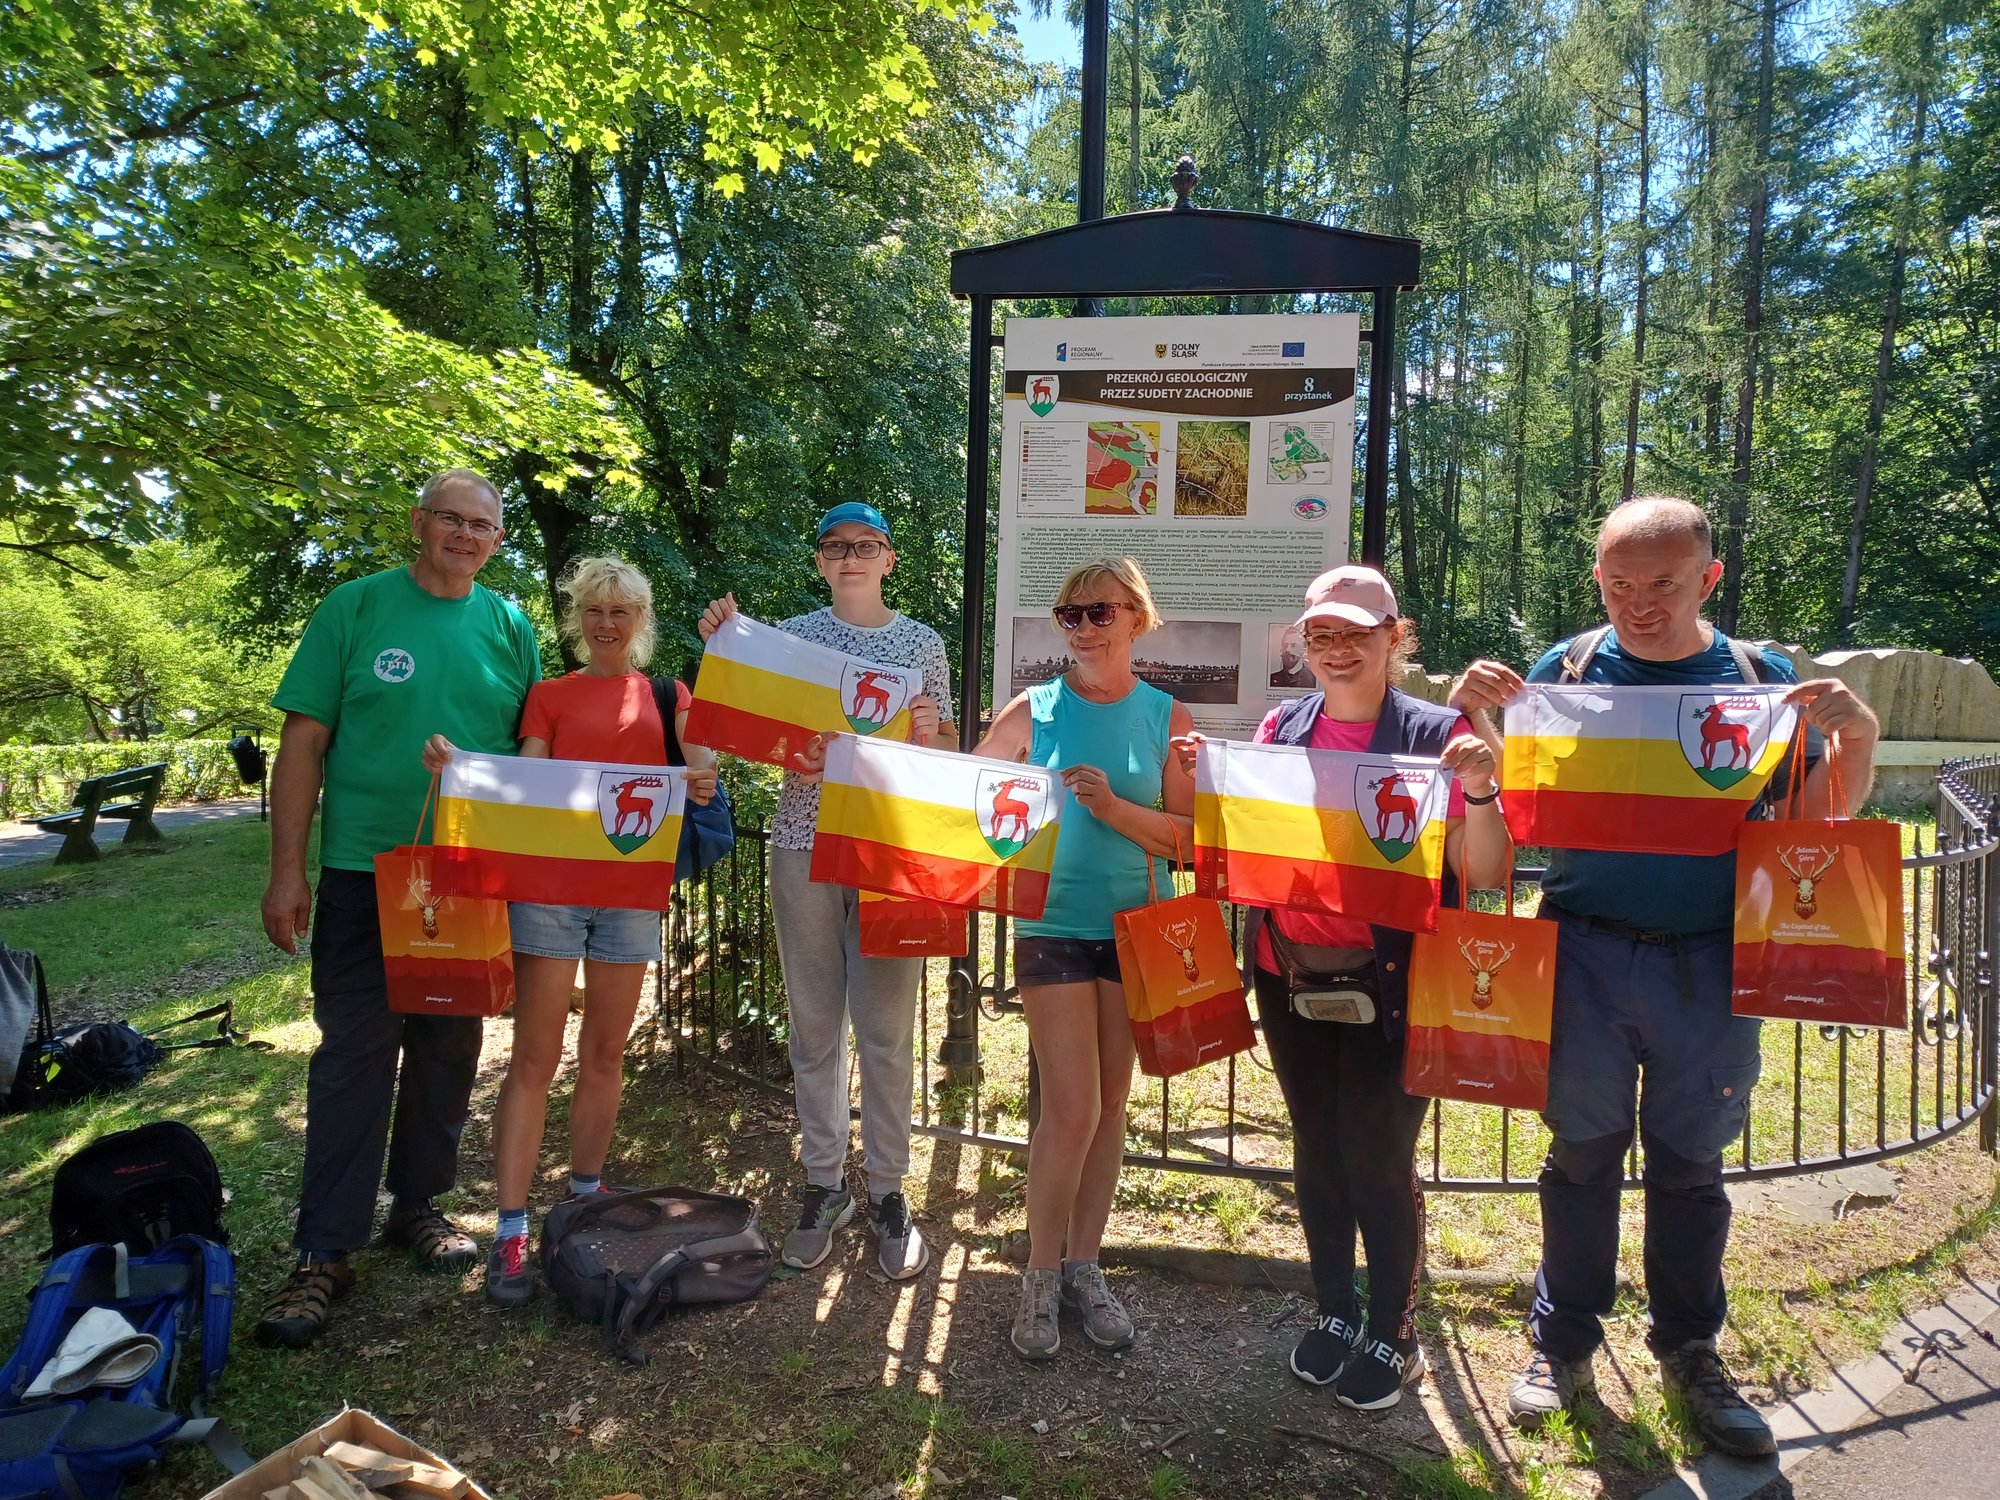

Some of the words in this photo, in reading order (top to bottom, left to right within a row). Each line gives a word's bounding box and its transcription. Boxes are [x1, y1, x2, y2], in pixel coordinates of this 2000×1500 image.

[1171, 343, 1200, 351] DOLNY
[1106, 371, 1163, 383] PRZEKRÓJ
[1166, 372, 1248, 383] GEOLOGICZNY
[1304, 377, 1315, 392] 8
[1100, 389, 1135, 399] PRZEZ
[1137, 388, 1182, 399] SUDETY
[1184, 388, 1253, 398] ZACHODNIE
[1284, 391, 1333, 402] przystanek
[1795, 846, 1820, 855] Jelenia
[1798, 855, 1816, 863] Góra
[1791, 923, 1813, 931] Capital
[1784, 994, 1825, 1004] jeleniagora.pl
